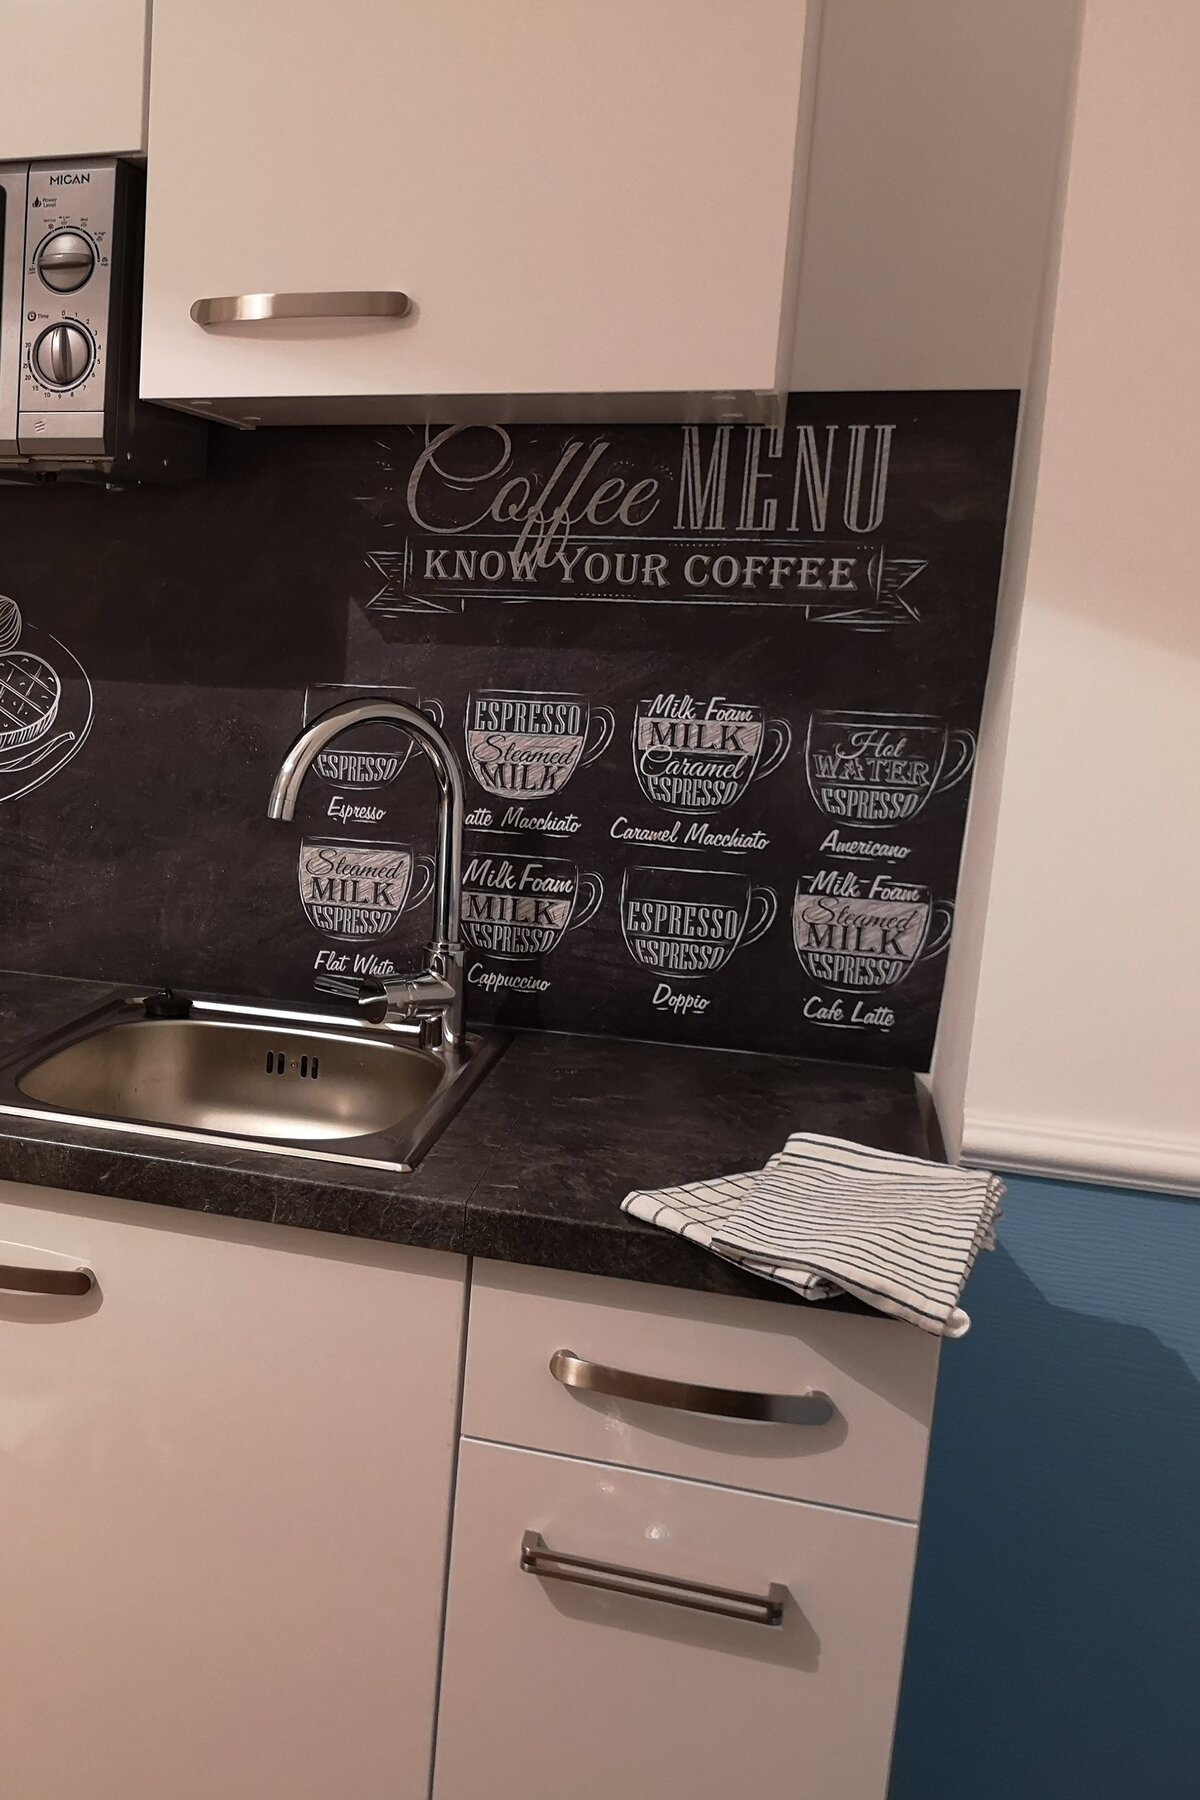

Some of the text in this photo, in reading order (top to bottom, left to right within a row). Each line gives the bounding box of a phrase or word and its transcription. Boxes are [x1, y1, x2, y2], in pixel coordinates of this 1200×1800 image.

[49, 173, 91, 186] MICAN
[407, 424, 896, 568] Coffee MENU
[423, 546, 859, 591] KNOW YOUR COFFEE
[475, 701, 580, 735] ESPRESSO
[648, 693, 753, 721] Milk Foam
[472, 735, 579, 764] Steamed
[649, 722, 749, 753] MILK
[317, 754, 398, 782] ESPRESSO
[479, 763, 564, 791] MILK
[641, 745, 748, 779] Caramel
[813, 754, 930, 787] WATER
[648, 776, 738, 806] ESPRESSO
[821, 788, 919, 819] ESPRESSO
[327, 796, 386, 824] Espresso
[464, 807, 582, 832] atte Macchiato
[610, 817, 771, 850] Caramel Macchiato
[819, 829, 911, 858] Americano
[305, 850, 402, 878] Steamed
[462, 859, 574, 893] Milk Foam
[310, 877, 398, 906] MILK
[809, 870, 920, 902] Milk Foam
[313, 908, 392, 935] ESPRESSO
[467, 895, 566, 927] MILK
[626, 901, 738, 940] ESPRESSO
[802, 897, 918, 932] Steamed
[471, 924, 554, 953] ESPRESSO
[804, 923, 909, 957] MILK
[314, 950, 395, 975] Flat White
[636, 939, 725, 970] ESPRESSO
[807, 953, 904, 985] ESPRESSO
[468, 963, 551, 992] Cappuccino
[653, 984, 710, 1014] Doppio
[802, 996, 896, 1026] Cafe Latte
